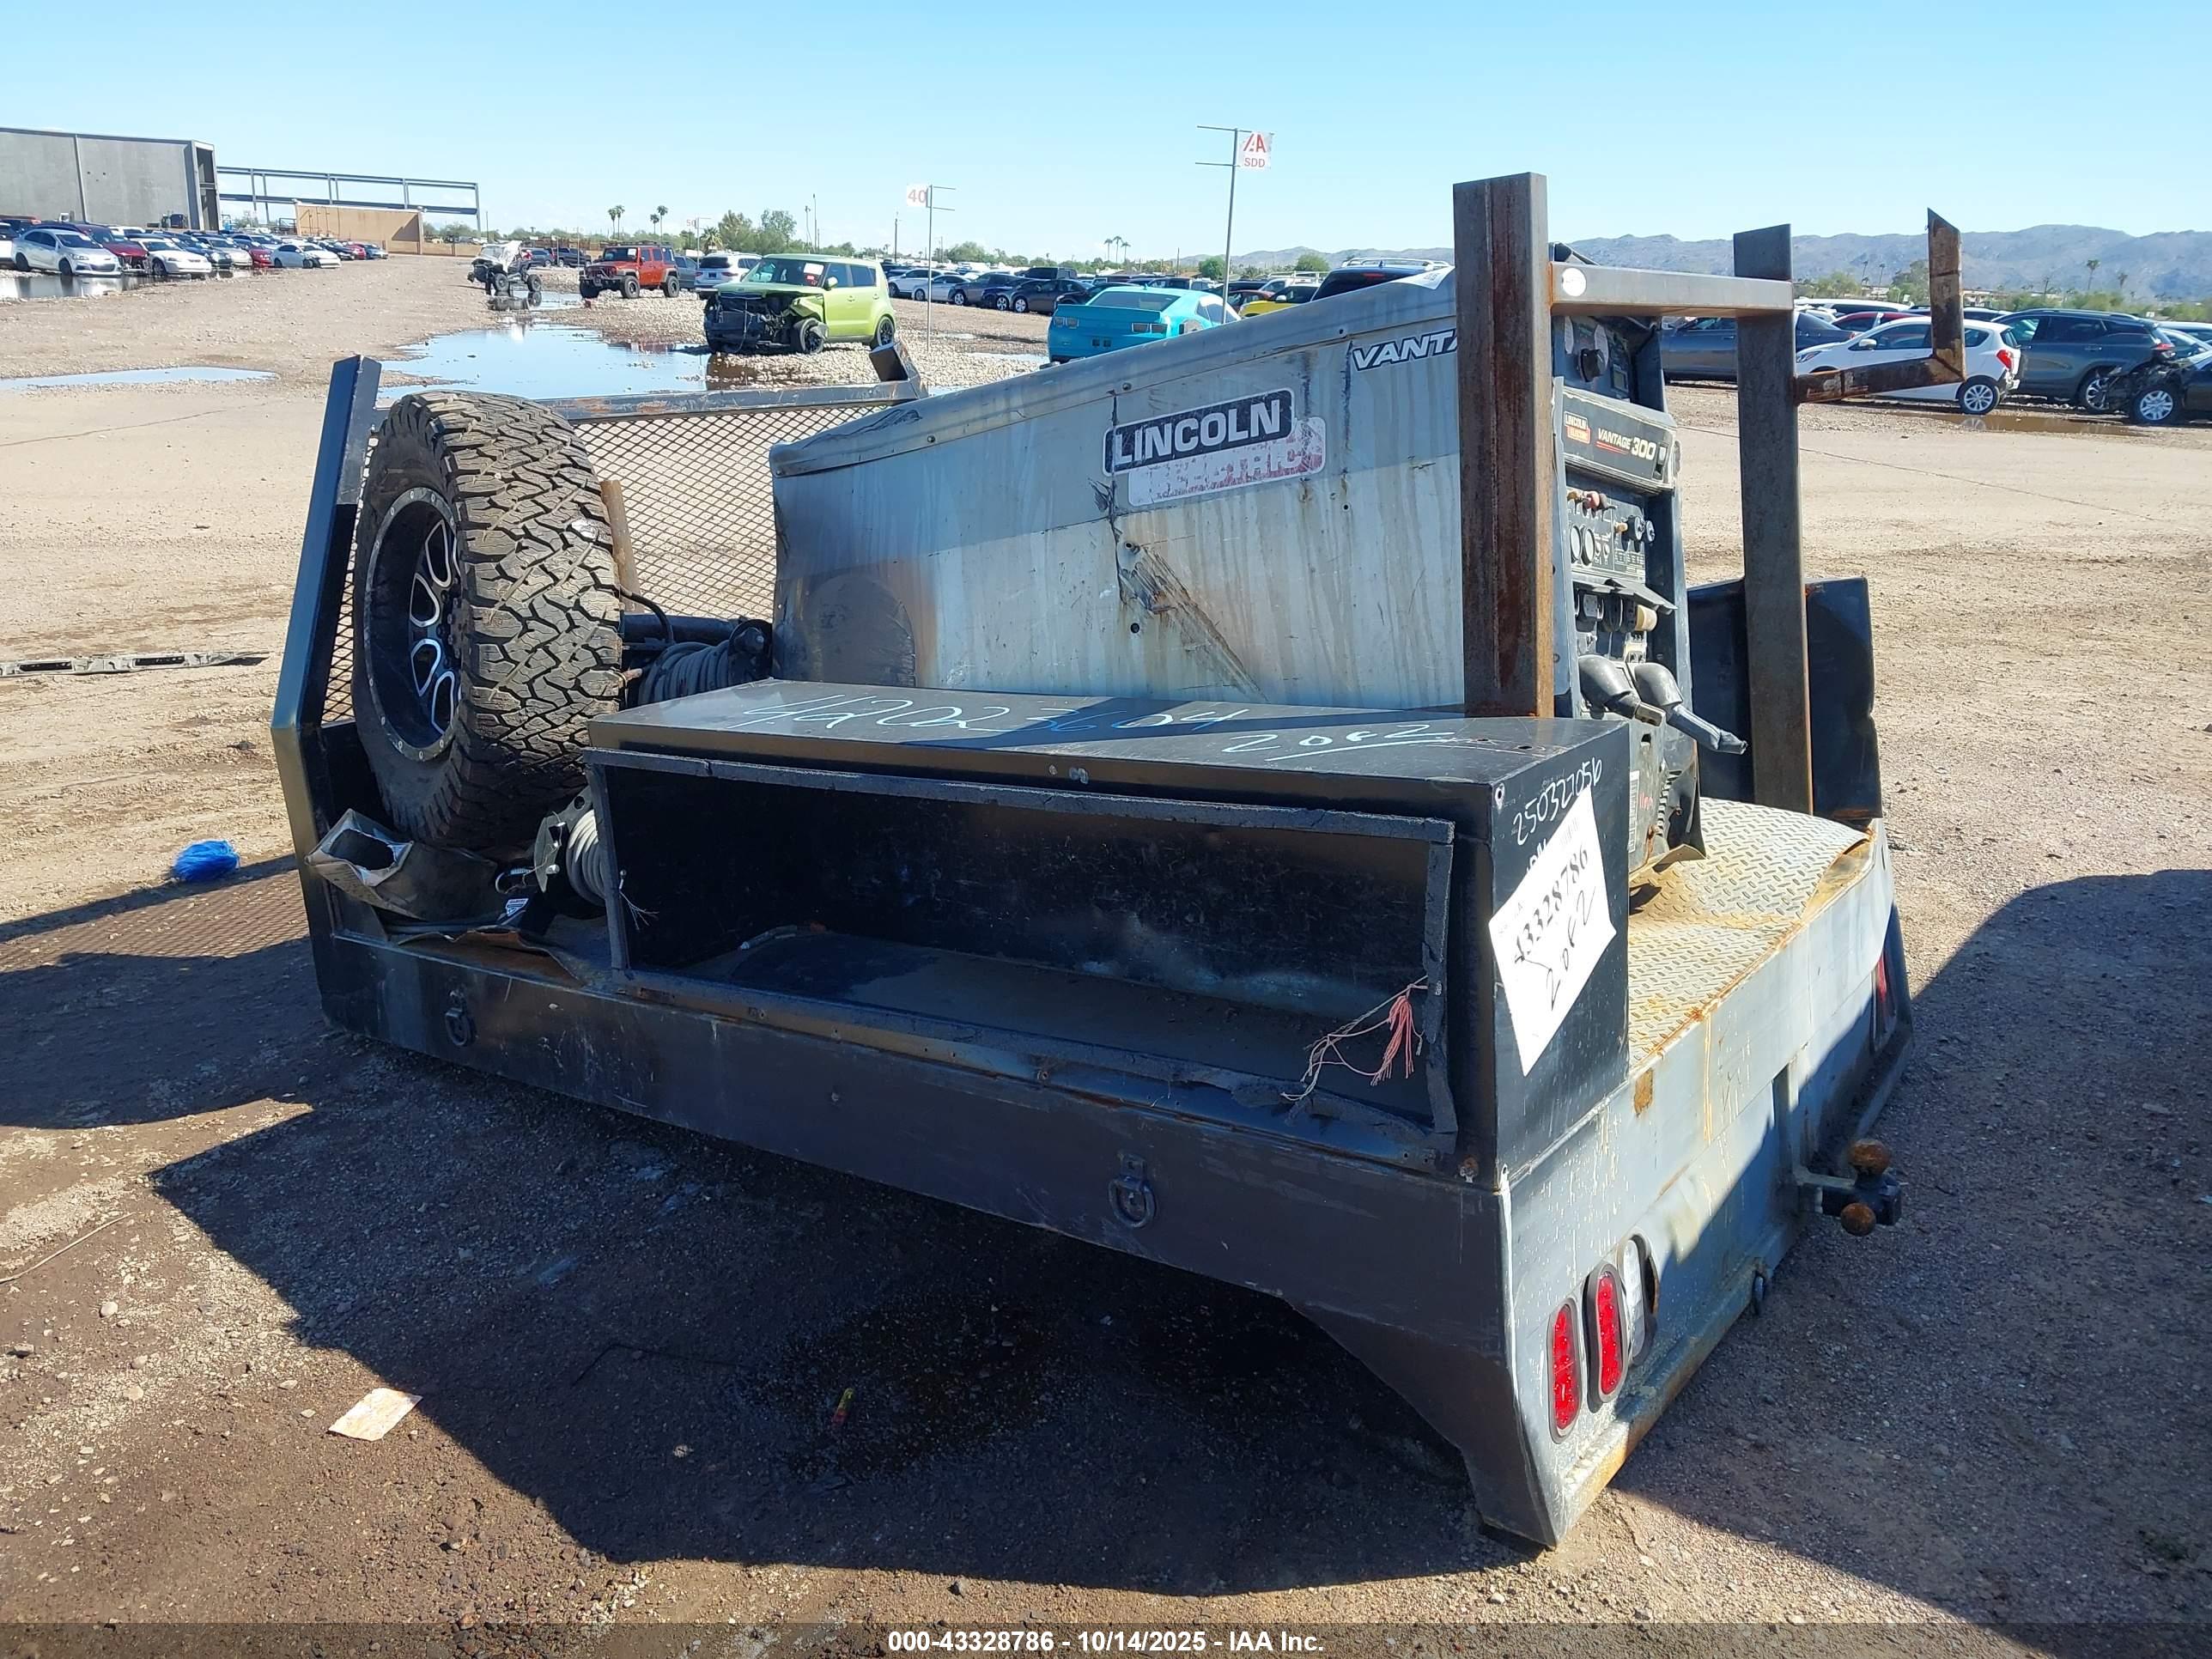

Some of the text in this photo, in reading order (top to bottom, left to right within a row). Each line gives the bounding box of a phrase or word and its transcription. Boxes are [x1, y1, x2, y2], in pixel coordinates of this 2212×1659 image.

[1243, 157, 1266, 167] SDD
[908, 189, 927, 203] 40
[1352, 329, 1457, 371] VANT
[1114, 399, 1280, 465] LINCOLN
[1565, 414, 1587, 430] LINCOLN
[1598, 428, 1656, 460] VANTAGE 300
[1514, 844, 1589, 963] 43328786
